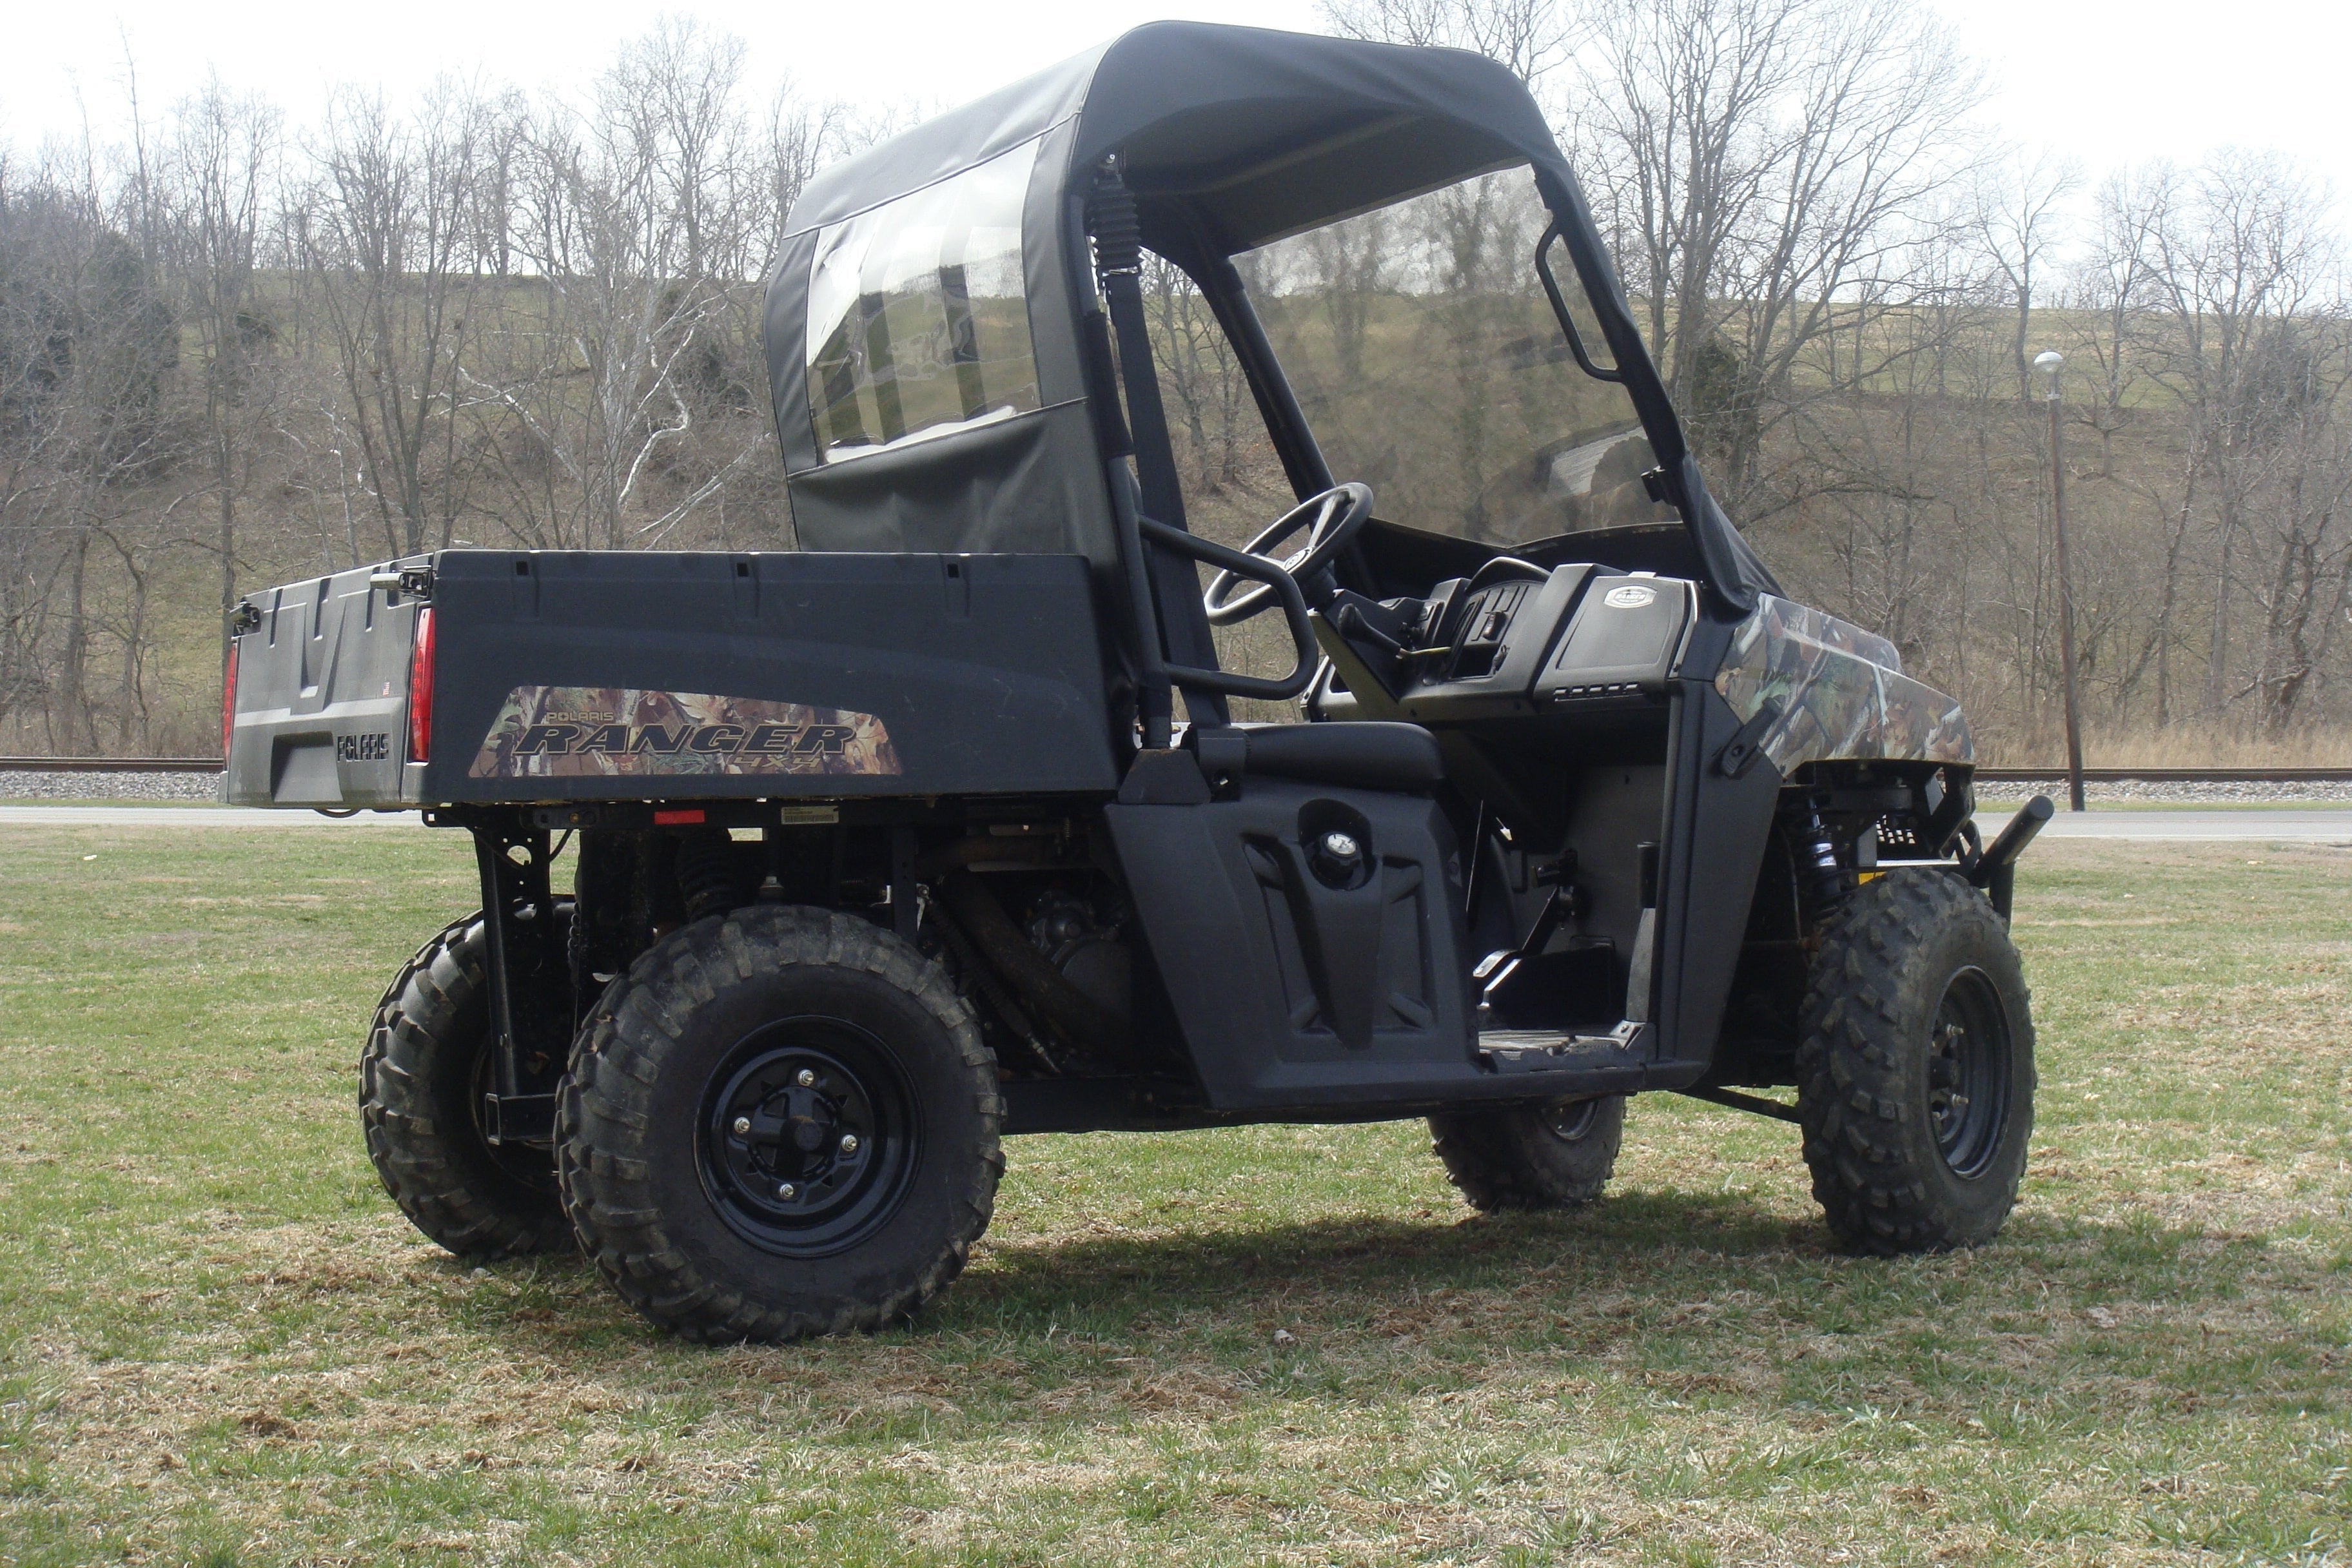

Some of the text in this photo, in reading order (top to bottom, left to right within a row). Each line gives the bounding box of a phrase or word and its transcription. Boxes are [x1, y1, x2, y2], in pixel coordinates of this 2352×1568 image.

[545, 711, 614, 721] POLARIS
[337, 732, 389, 762] POLARIS
[513, 724, 857, 754] RANGER
